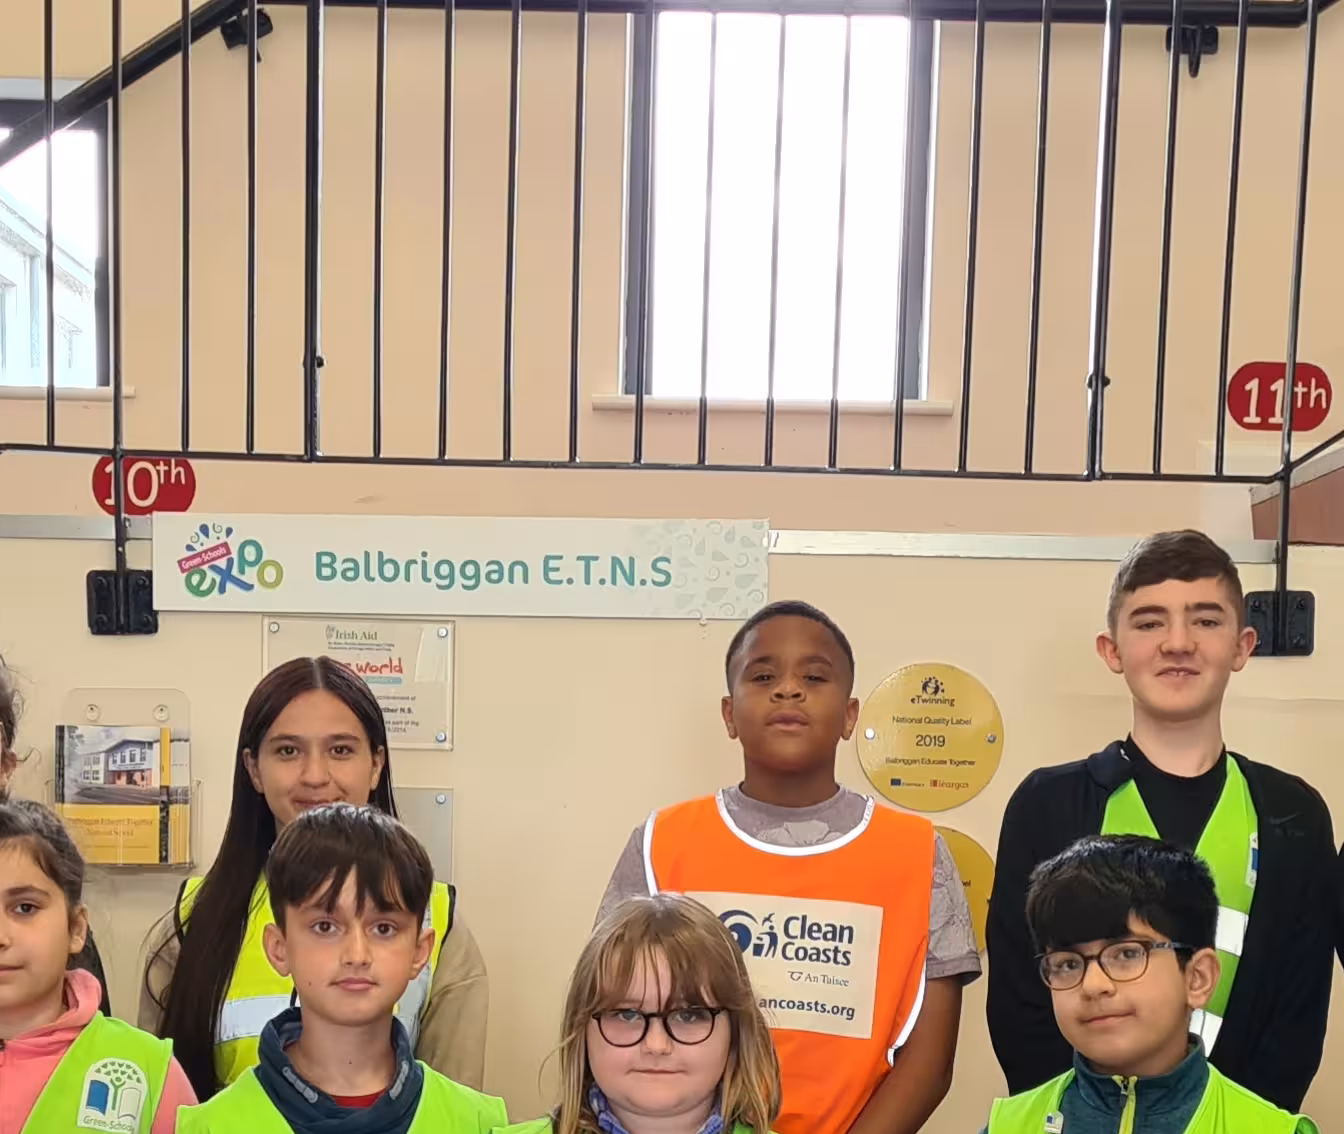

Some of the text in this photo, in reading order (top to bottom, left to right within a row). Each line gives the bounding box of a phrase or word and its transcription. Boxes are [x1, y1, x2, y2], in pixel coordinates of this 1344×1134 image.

[1242, 377, 1327, 424] 11th
[185, 539, 284, 598] expo
[315, 550, 673, 591] Balbriggan E.T.N.S
[336, 630, 378, 641] Irish Aid
[355, 656, 403, 675] world
[910, 695, 956, 707] eTwinning
[892, 716, 972, 726] National Quality Label
[915, 734, 946, 748] 2019
[781, 914, 854, 967] Clean Coasts
[805, 973, 819, 983] An
[758, 998, 856, 1021] ancoasts.org
